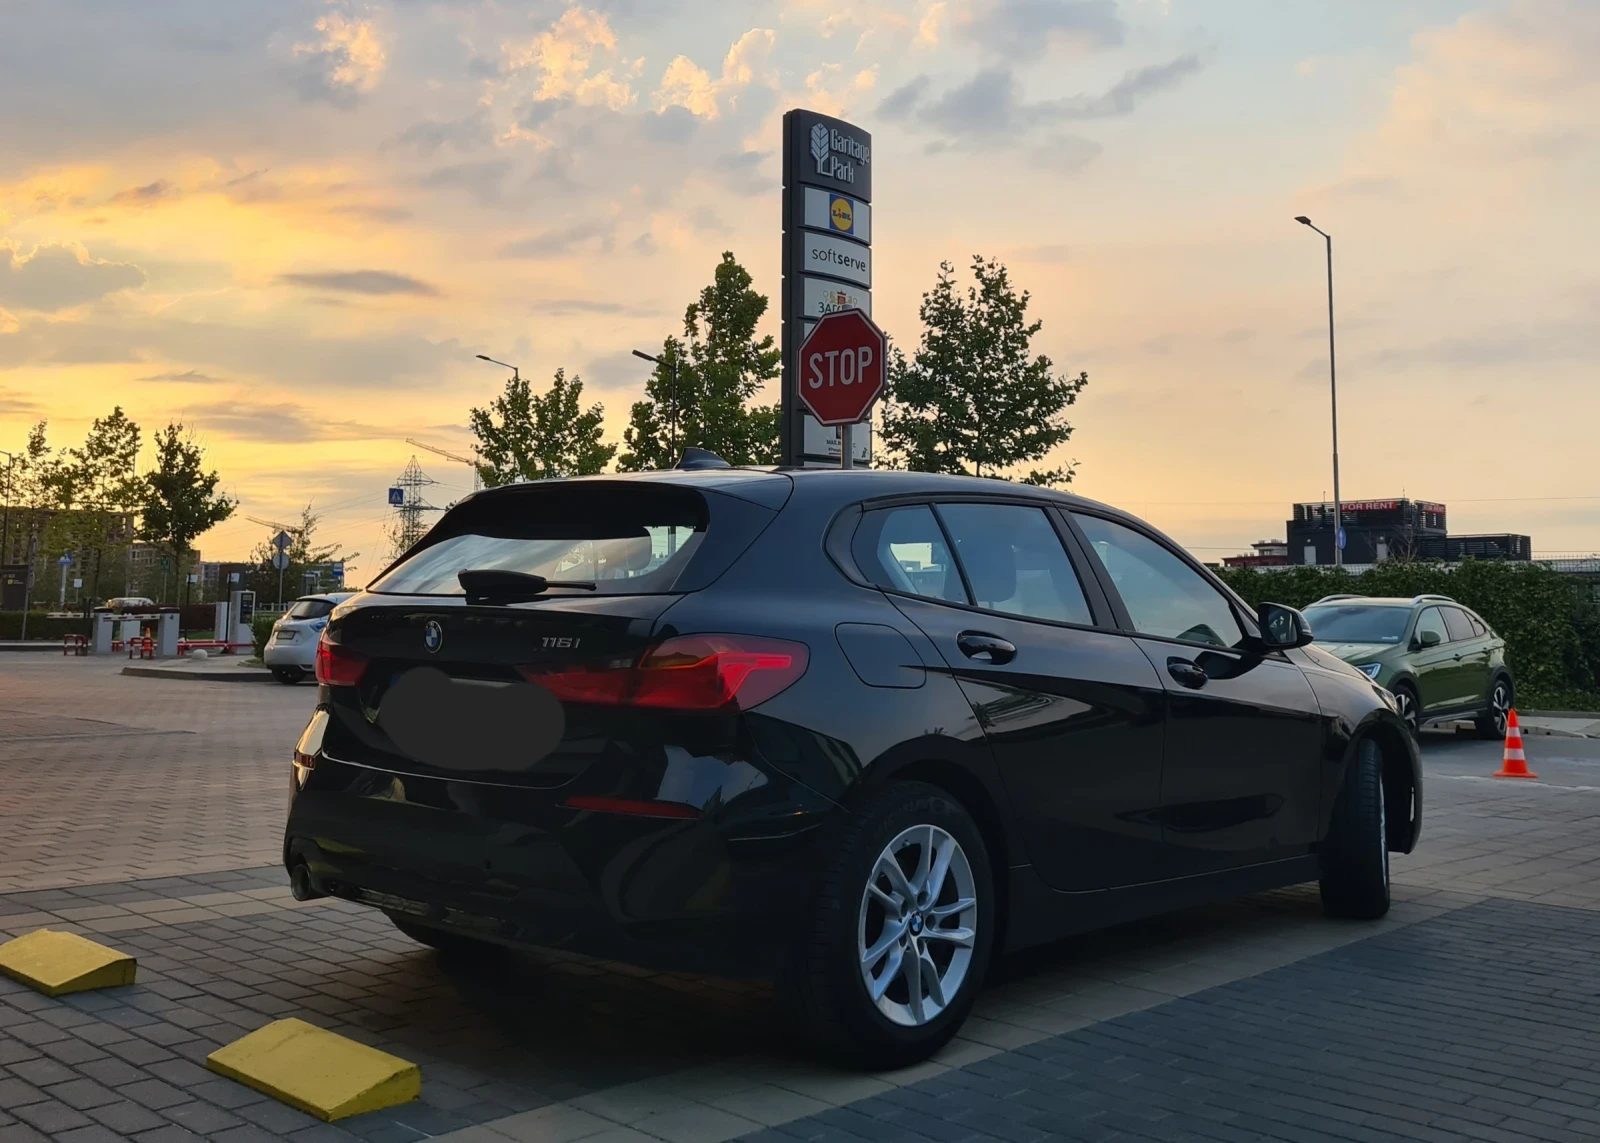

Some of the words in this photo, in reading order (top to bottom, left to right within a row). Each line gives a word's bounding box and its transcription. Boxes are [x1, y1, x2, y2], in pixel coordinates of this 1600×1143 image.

[830, 128, 869, 165] Garitage
[831, 156, 854, 183] Park
[812, 249, 865, 272] softserve
[808, 346, 873, 389] STOP
[1342, 503, 1362, 511] FOR
[1366, 501, 1394, 511] RENT
